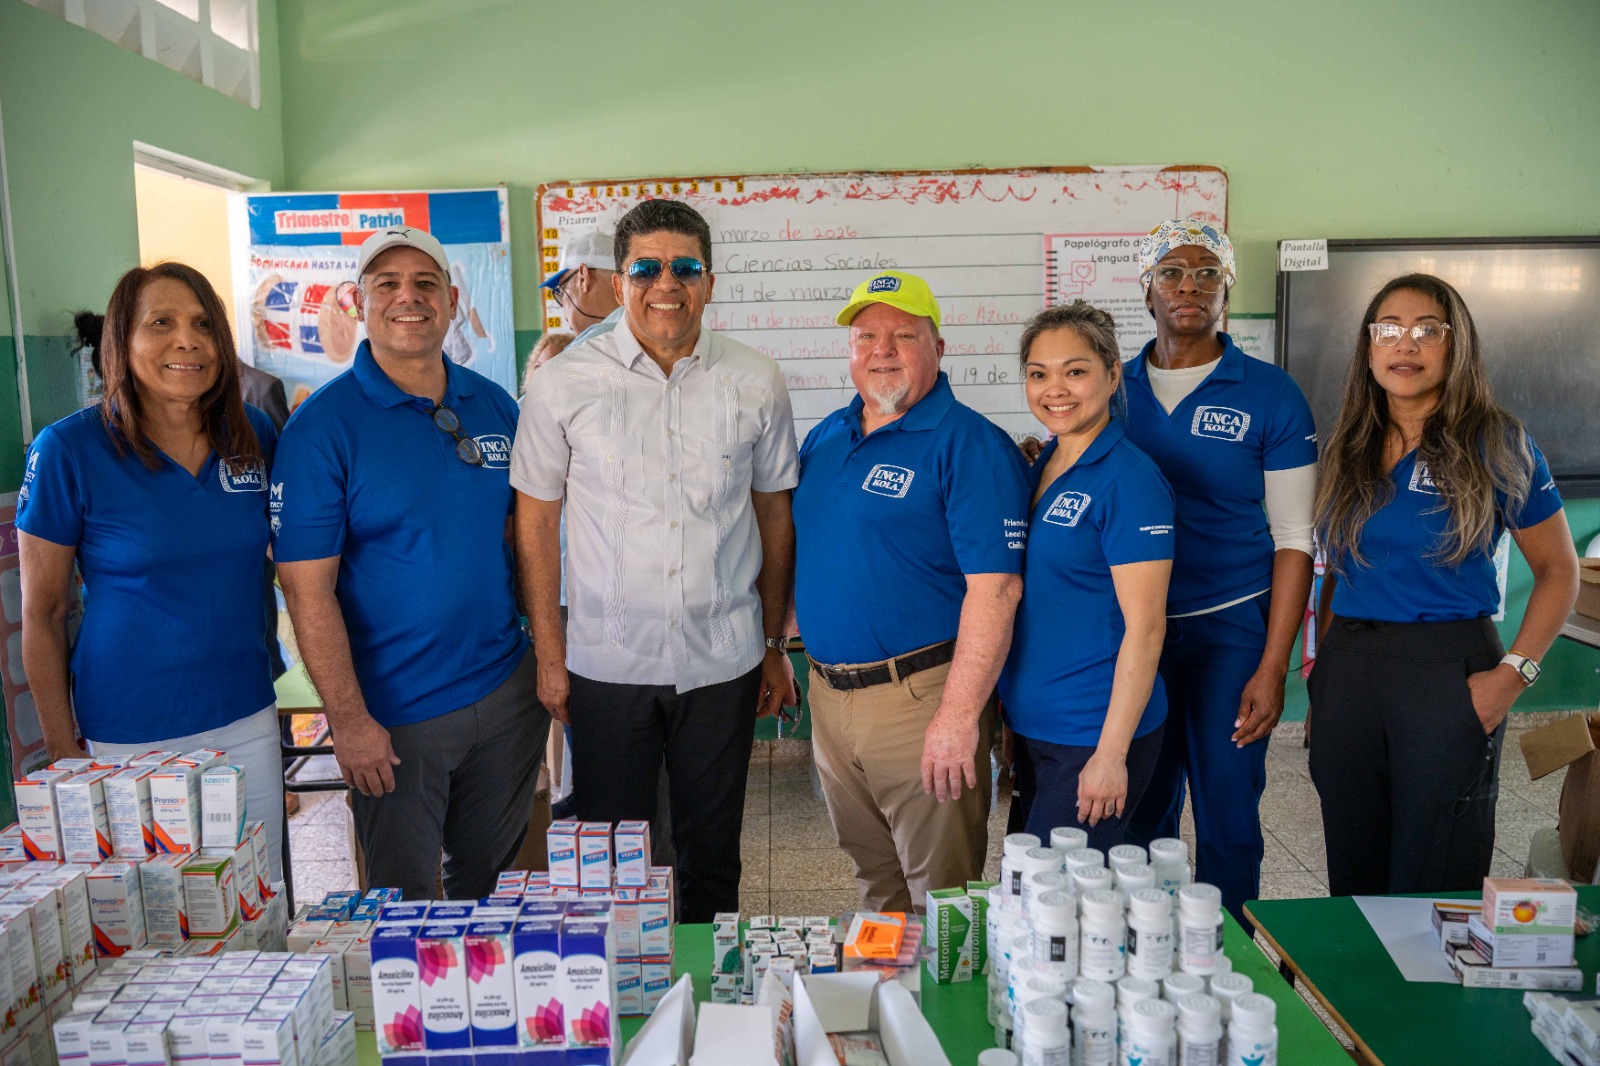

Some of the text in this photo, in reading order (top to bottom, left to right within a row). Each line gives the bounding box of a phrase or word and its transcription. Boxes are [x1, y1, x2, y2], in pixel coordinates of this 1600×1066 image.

[566, 189, 573, 198] 0
[277, 212, 350, 229] Trimestre
[558, 216, 597, 225] Pizarra
[546, 229, 558, 239] 10
[720, 218, 858, 242] marzo de 2026
[1064, 239, 1130, 250] Papelógrafo
[1284, 242, 1325, 252] Pantalla
[545, 247, 558, 257] 20
[311, 260, 342, 270] HASTA
[344, 261, 357, 270] LA
[725, 251, 898, 273] Ciencias Sociales
[1091, 254, 1130, 264] Lengua
[1284, 257, 1321, 269] Digital
[546, 263, 558, 272] 30
[730, 282, 853, 301] 19 de marzo
[709, 310, 734, 330] del
[746, 313, 759, 330] 19
[766, 308, 784, 328] de
[944, 304, 1021, 325] de Azua
[548, 317, 561, 327] 50
[789, 339, 850, 359] batalla
[984, 335, 1005, 354] de
[963, 367, 978, 384] 19
[987, 364, 1008, 384] de
[1201, 410, 1241, 427] INCA
[1203, 423, 1237, 435] KOLA
[480, 440, 507, 453] INCA
[487, 453, 508, 462] KOLA
[232, 474, 260, 485] KOLA
[874, 468, 905, 484] INCA
[872, 479, 900, 491] KOLA
[1057, 496, 1080, 511] INCA
[1050, 507, 1073, 520] KOLA
[1004, 530, 1021, 538] Lead
[585, 853, 604, 861] VERFIN
[645, 919, 664, 928] VERFIN
[940, 906, 950, 980] Metronidazol
